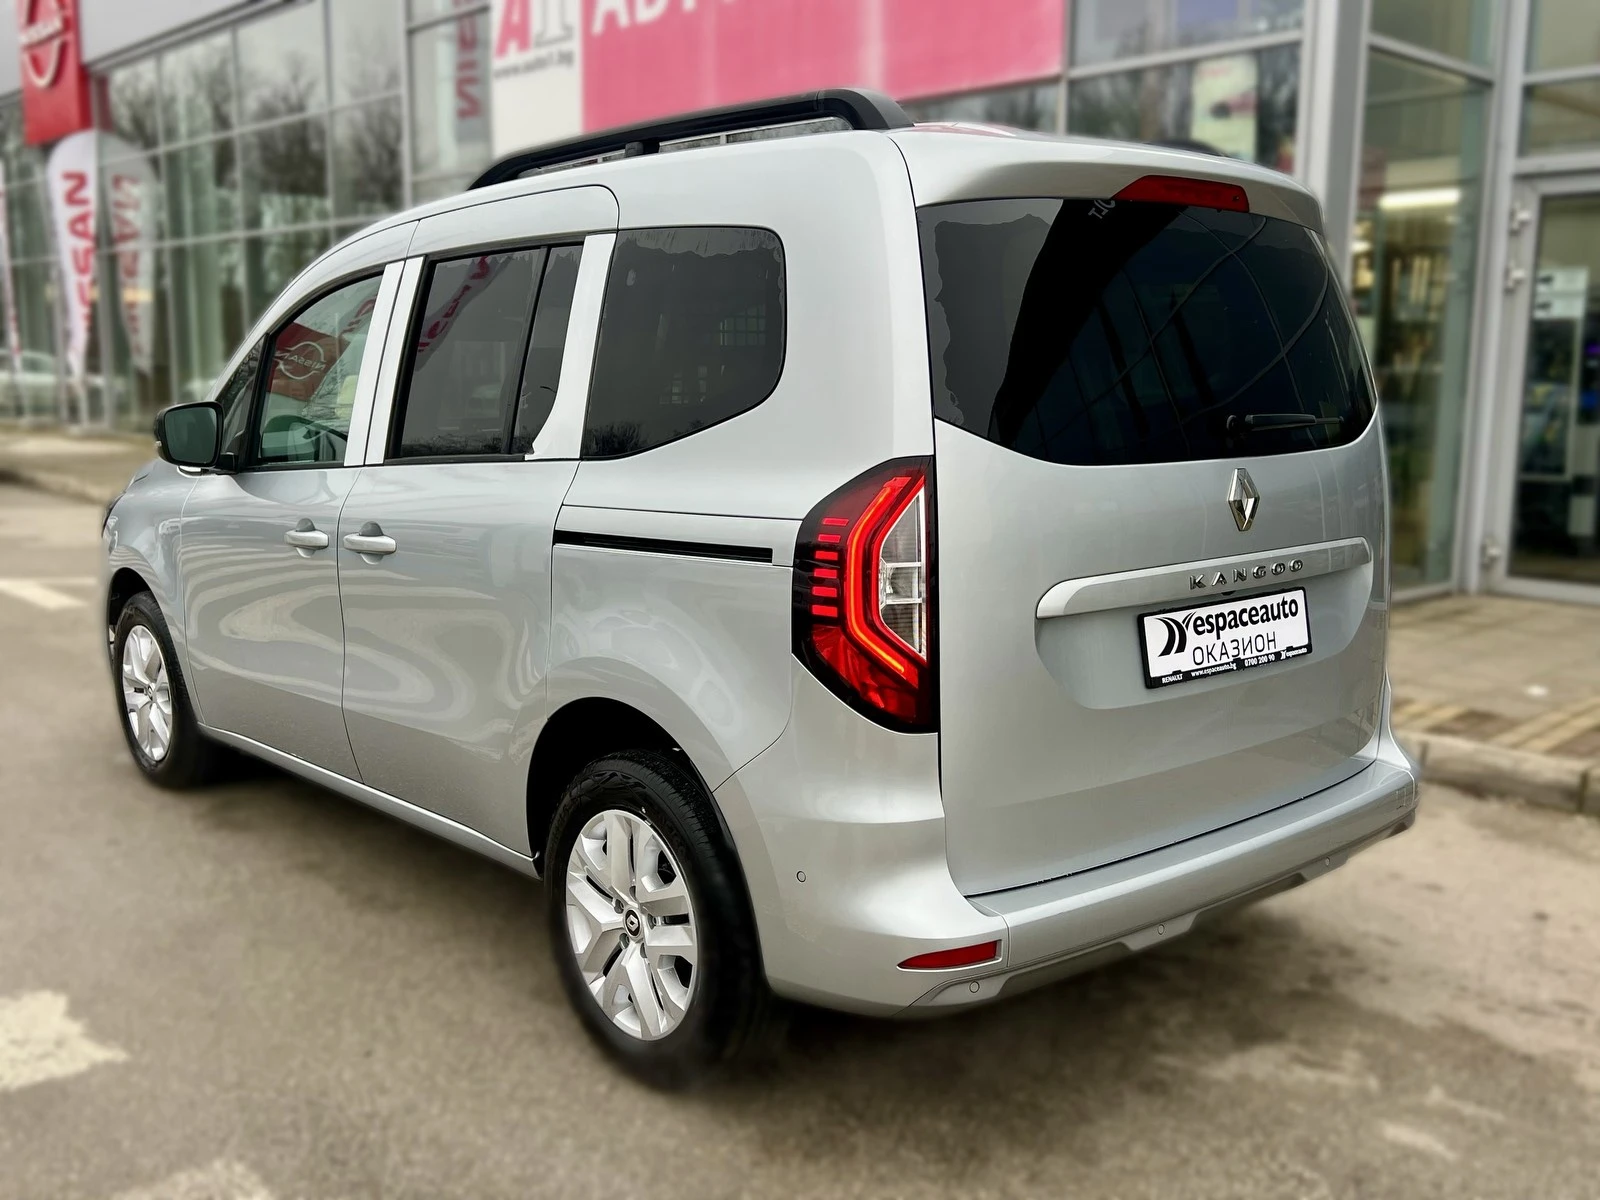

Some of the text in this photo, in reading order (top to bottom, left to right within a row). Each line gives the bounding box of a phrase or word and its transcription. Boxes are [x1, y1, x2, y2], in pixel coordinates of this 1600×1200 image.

[1190, 559, 1303, 589] KANGOO
[1193, 596, 1298, 640] espaceauto
[1192, 631, 1277, 666] ОКАЗИОН
[1161, 673, 1183, 684] RENAULT
[1191, 662, 1237, 677] www.espaceauto.bg
[1244, 656, 1258, 667] 0700
[1258, 655, 1268, 665] 200
